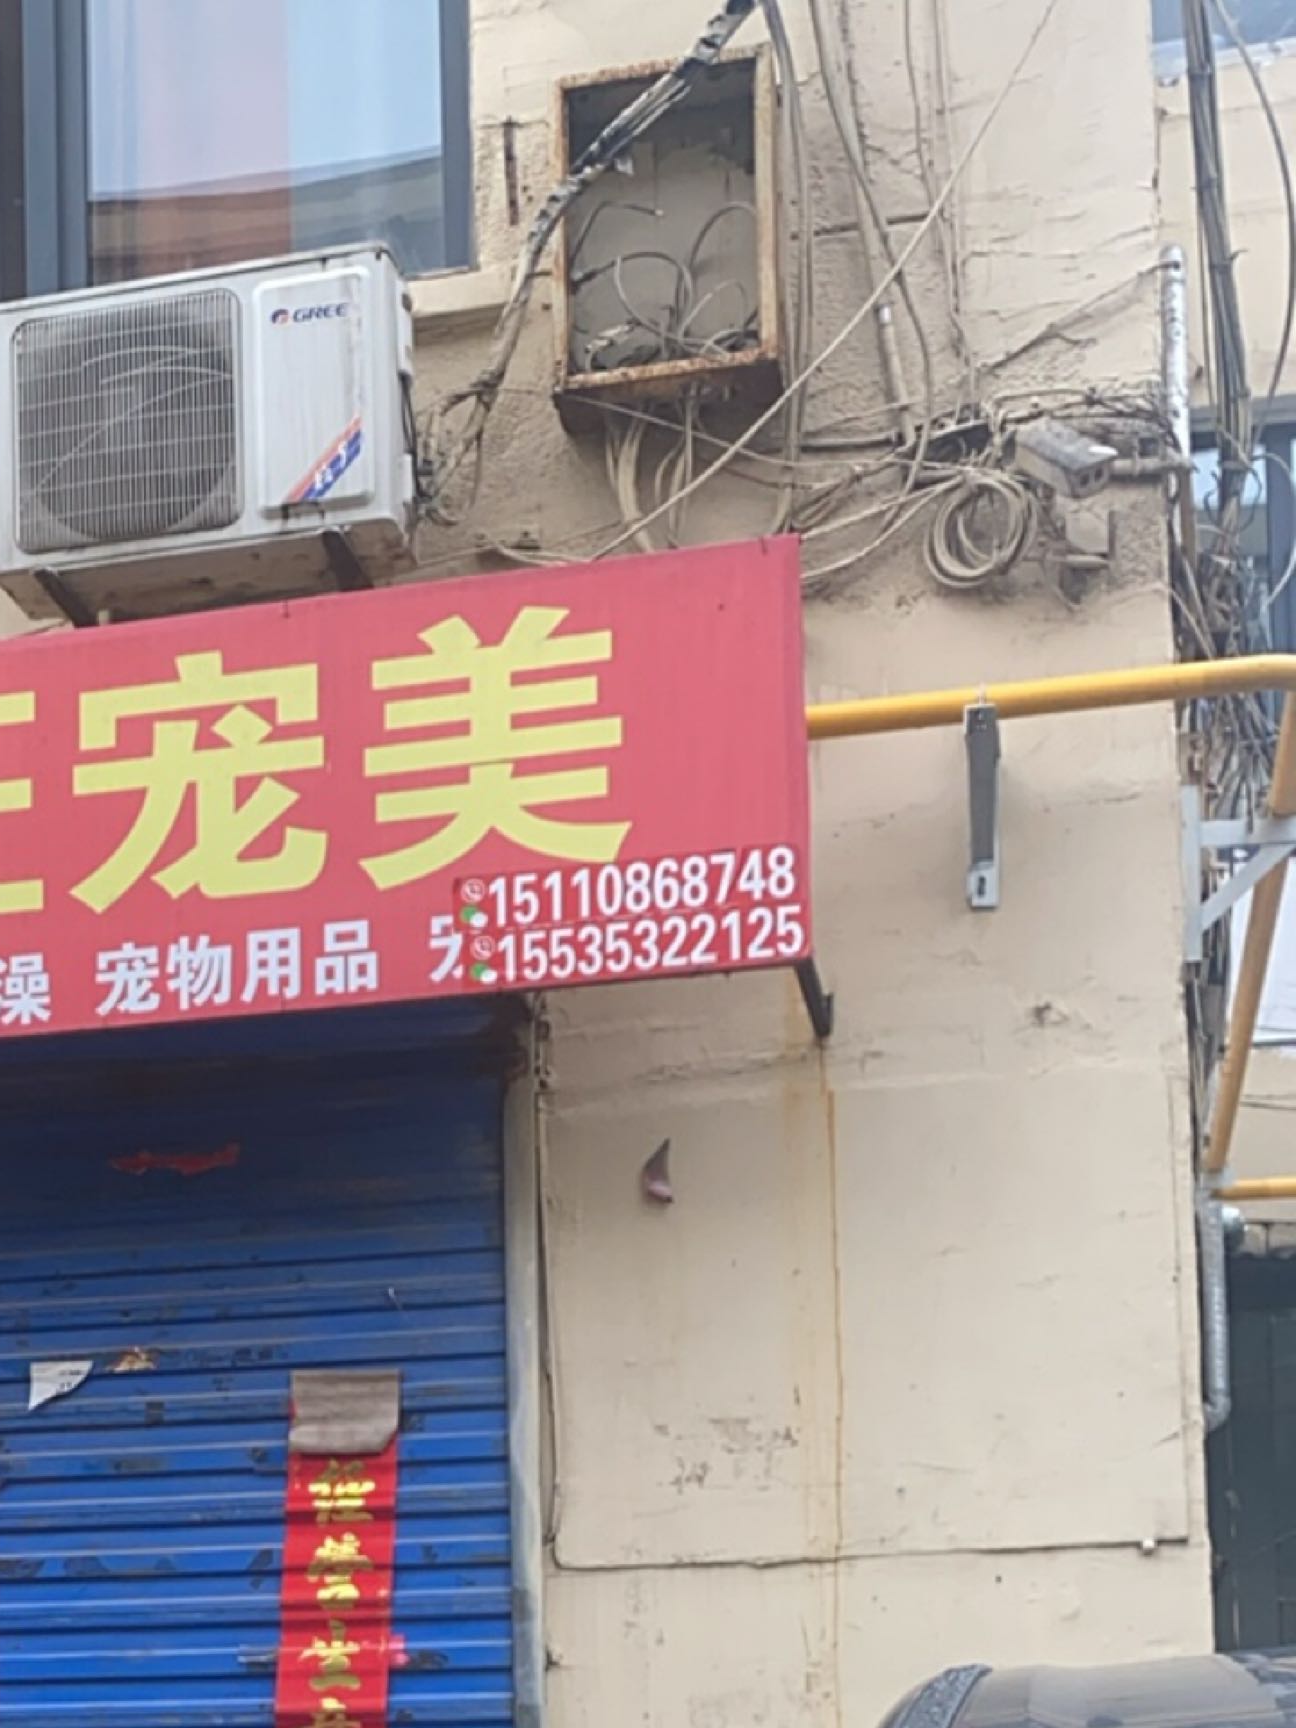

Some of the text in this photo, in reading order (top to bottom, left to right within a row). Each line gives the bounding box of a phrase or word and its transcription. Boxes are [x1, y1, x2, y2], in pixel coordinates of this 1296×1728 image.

[293, 304, 347, 323] GREE
[488, 847, 797, 925] 15110868748
[94, 919, 379, 1016] 宠物用品
[497, 904, 803, 982] 15535322125
